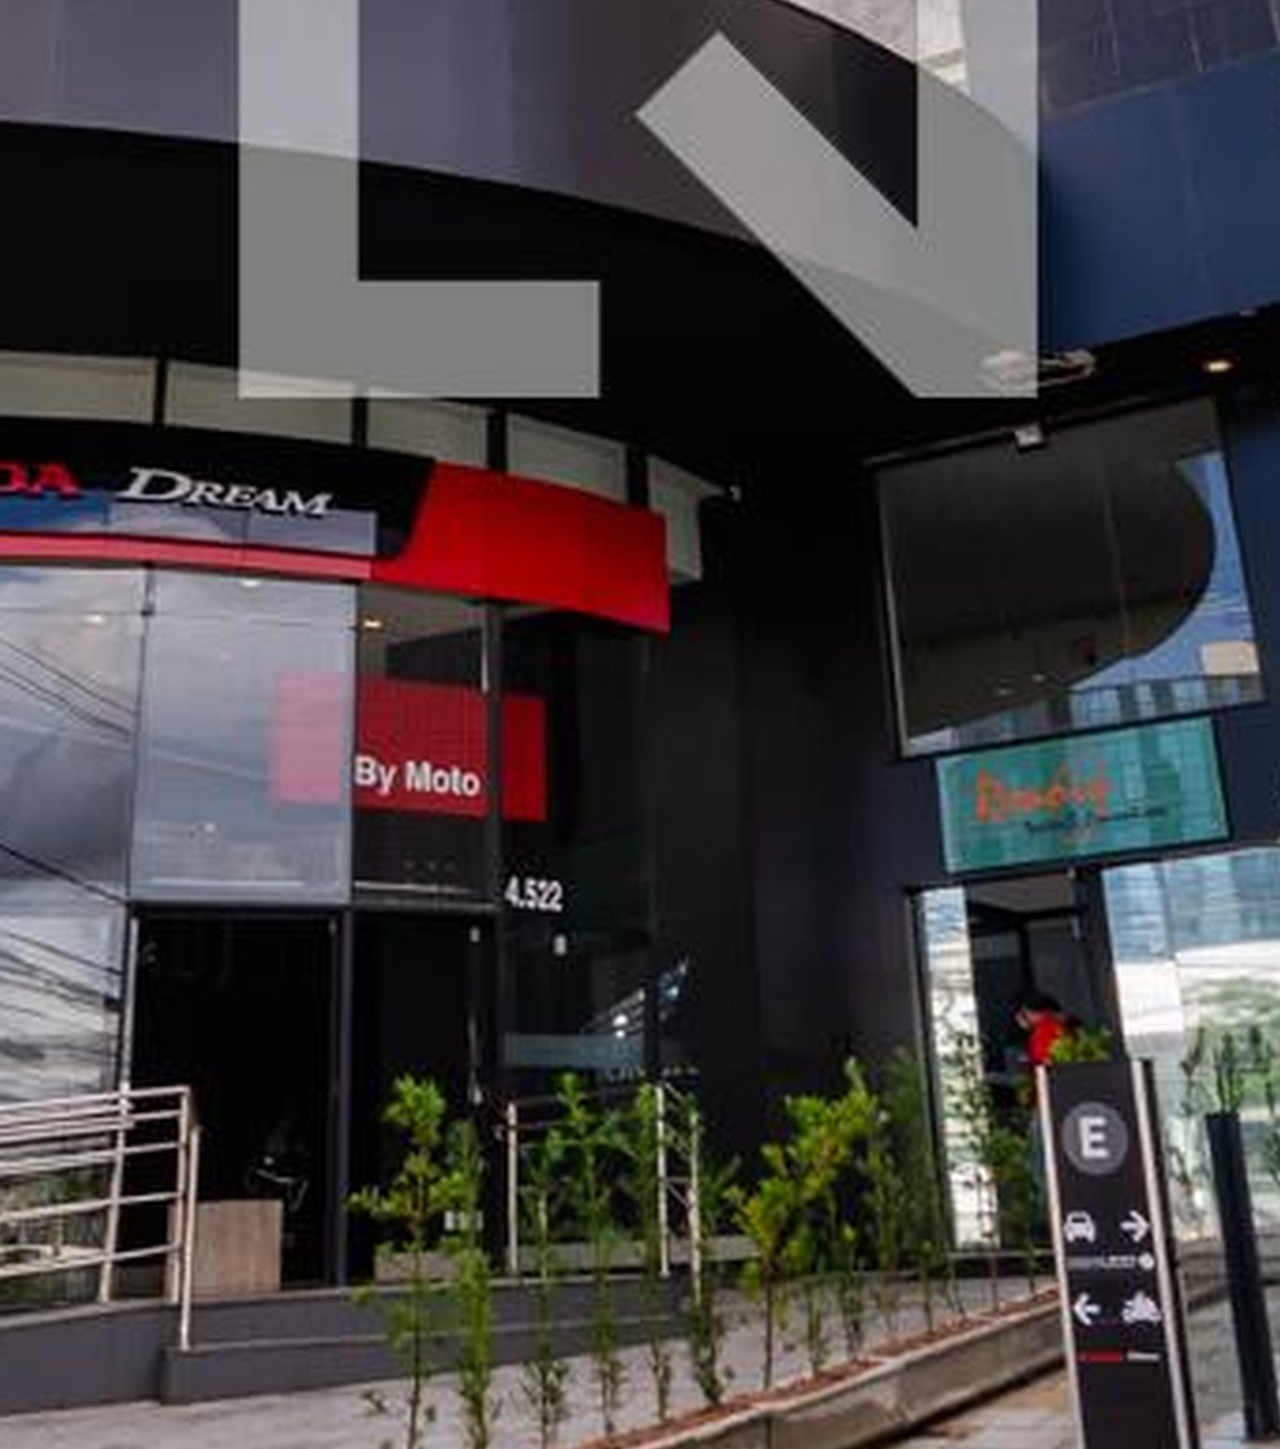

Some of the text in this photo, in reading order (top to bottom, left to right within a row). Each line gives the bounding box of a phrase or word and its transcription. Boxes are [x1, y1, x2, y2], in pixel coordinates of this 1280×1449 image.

[354, 755, 481, 797] By Moto
[504, 875, 564, 912] 4.522
[1079, 1117, 1110, 1159] E
